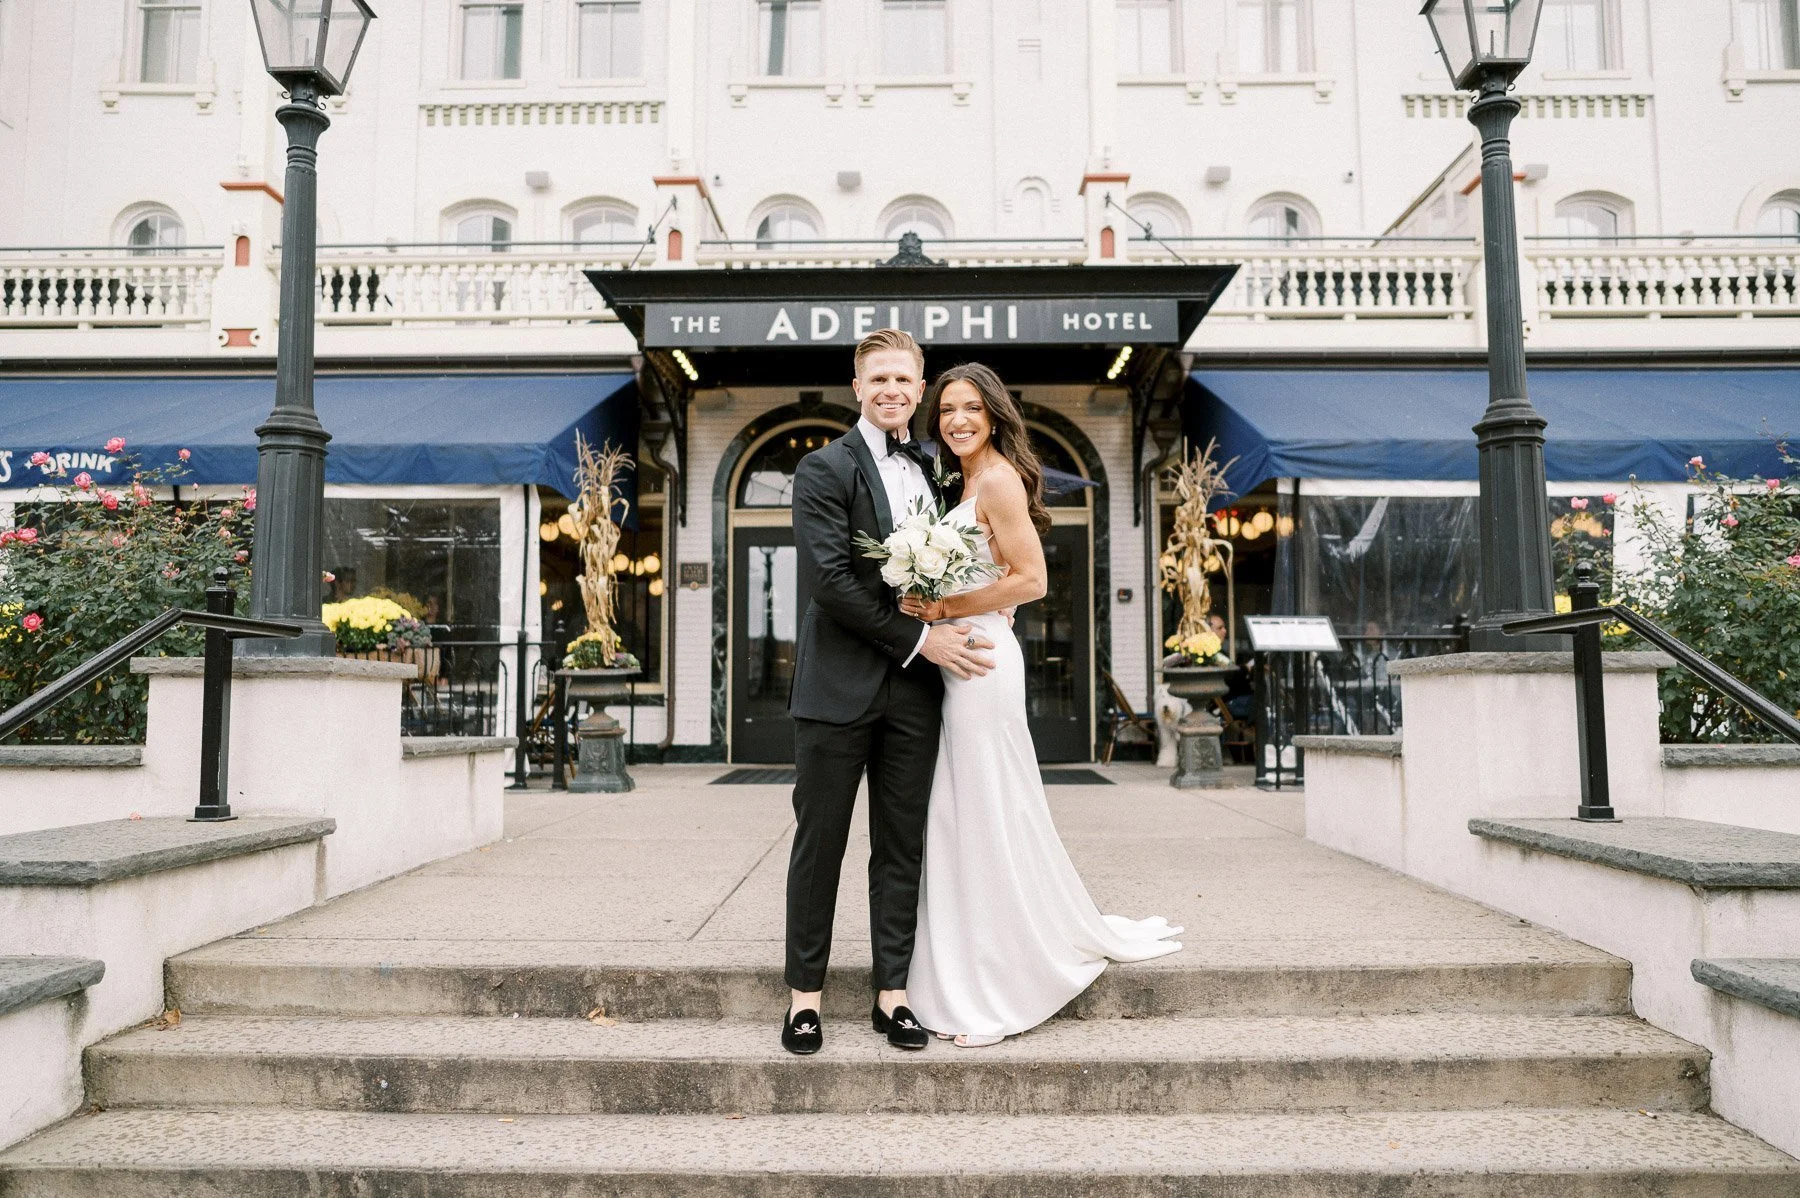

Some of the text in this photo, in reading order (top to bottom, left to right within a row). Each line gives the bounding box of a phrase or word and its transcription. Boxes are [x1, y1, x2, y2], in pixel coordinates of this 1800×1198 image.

[670, 305, 1152, 341] THE ADELPHI HOTEL
